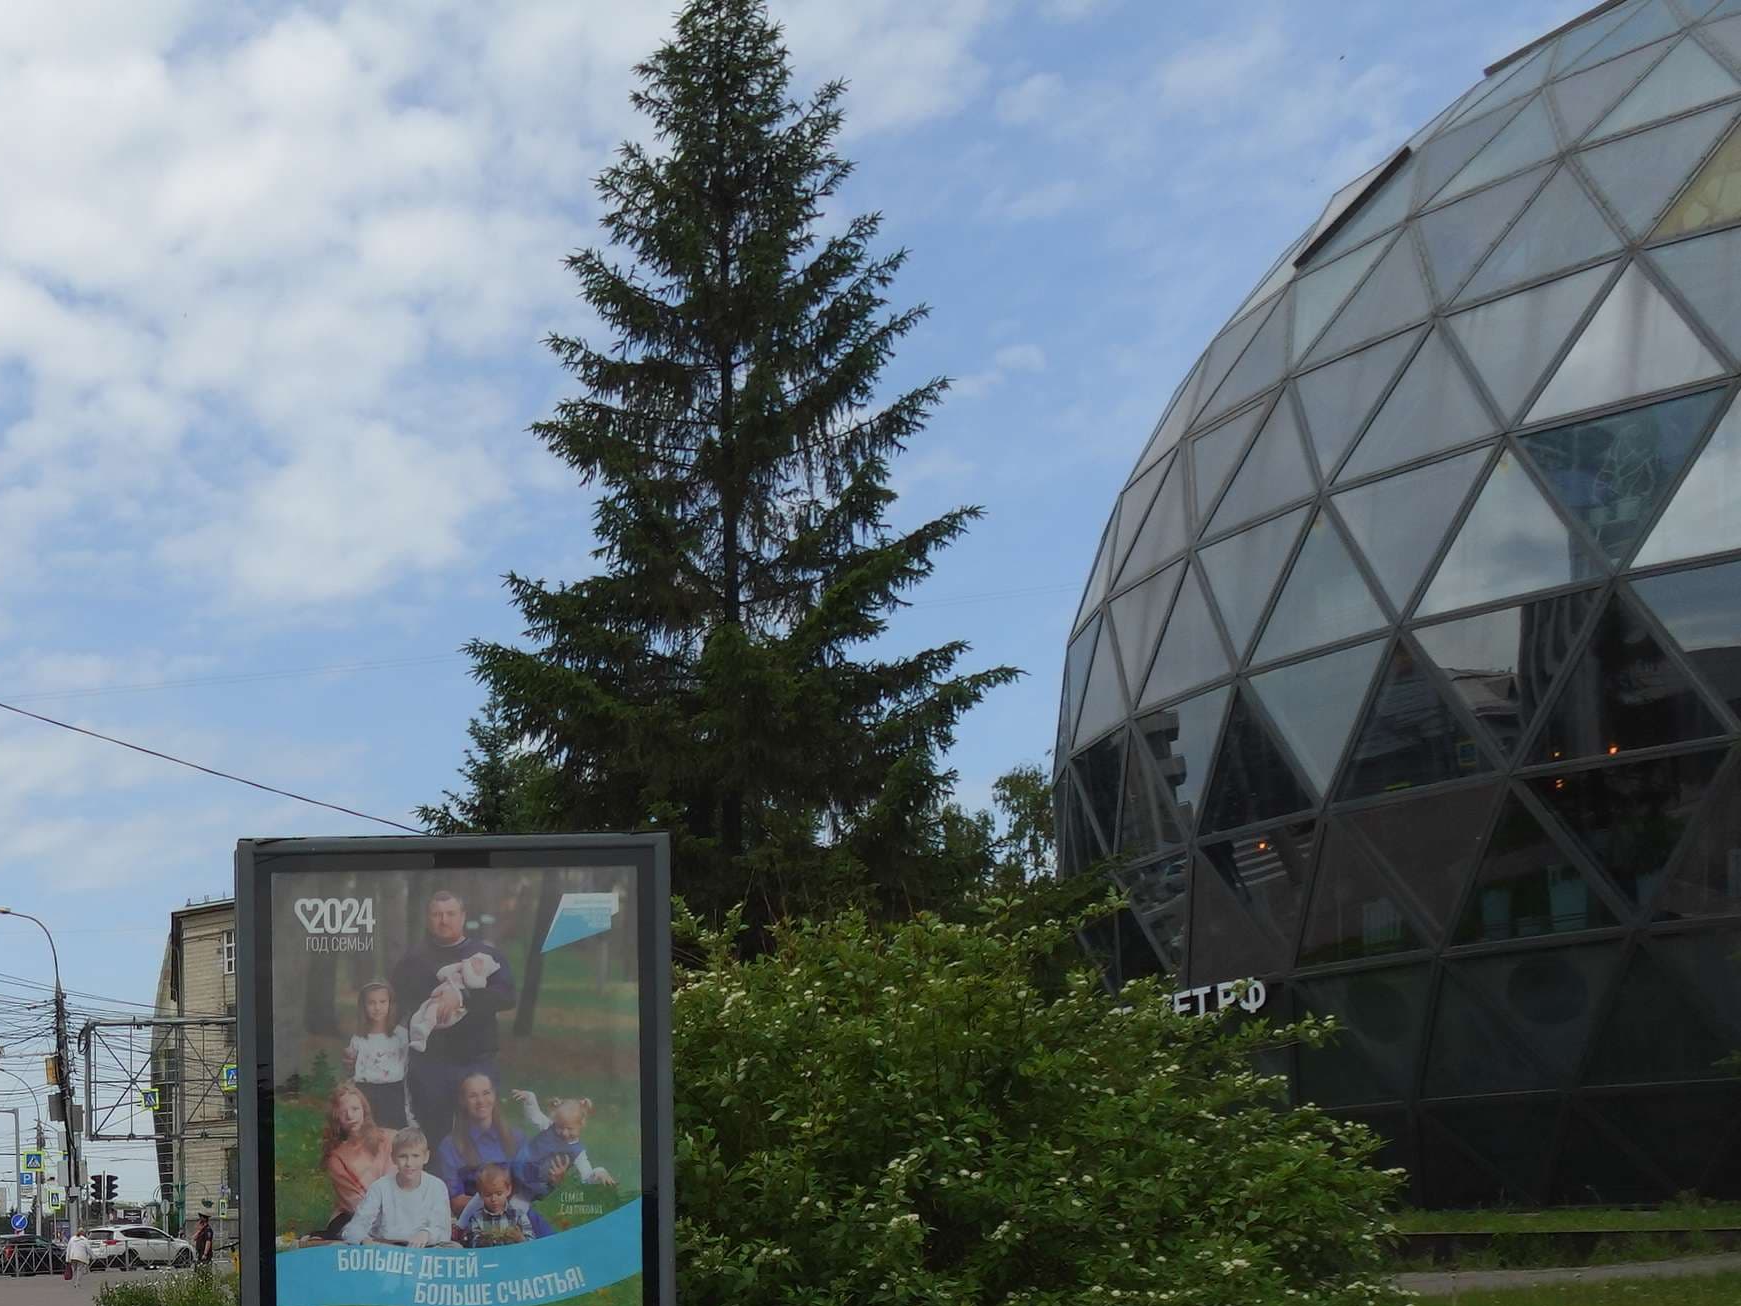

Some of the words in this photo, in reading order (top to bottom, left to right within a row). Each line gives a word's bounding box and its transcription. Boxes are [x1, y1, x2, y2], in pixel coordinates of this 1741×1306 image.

[300, 897, 376, 934] 2024
[337, 1248, 414, 1275] БОЛЬШЕ
[418, 1252, 478, 1279] ДЕТЕЙ
[414, 1282, 492, 1306] БОЛЬШЕ
[496, 1266, 586, 1304] СЧАСТЬЯ!
